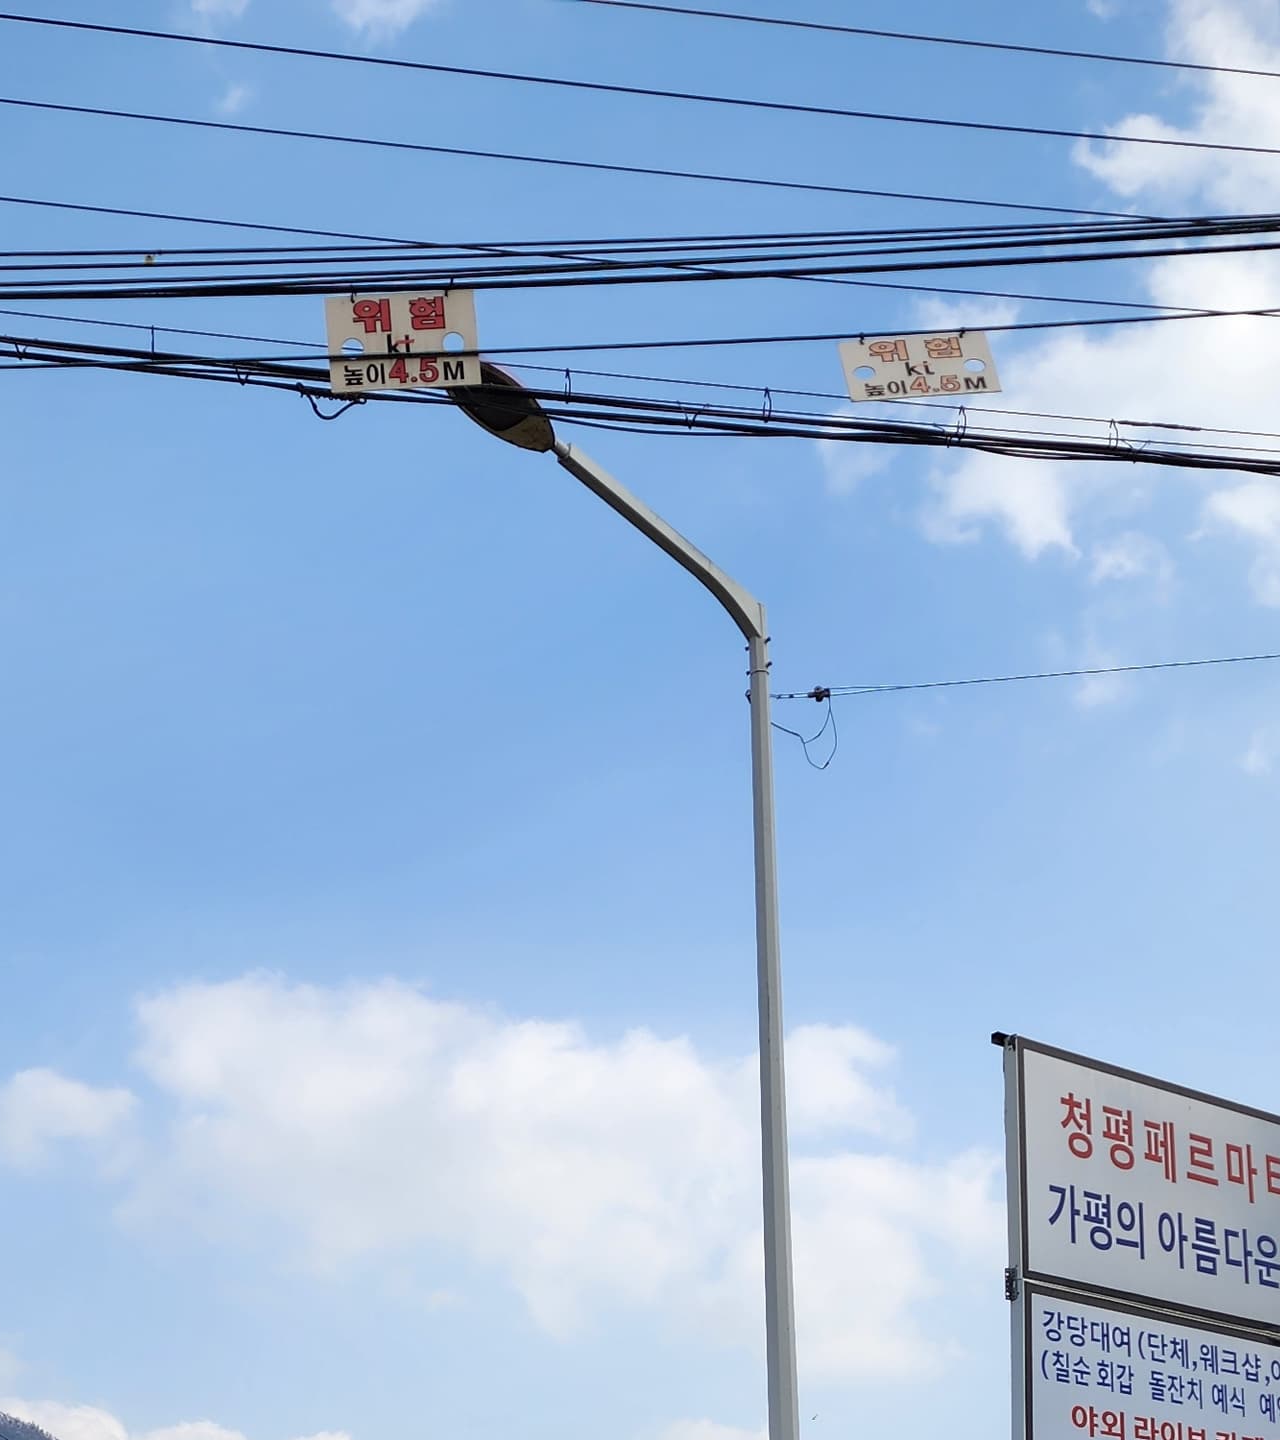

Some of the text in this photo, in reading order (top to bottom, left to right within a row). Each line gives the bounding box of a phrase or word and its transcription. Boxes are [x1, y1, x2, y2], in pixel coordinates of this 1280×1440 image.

[352, 296, 446, 333] 위험
[387, 334, 415, 353] kt
[869, 336, 963, 362] 위험
[1048, 1184, 1145, 1260] 가평의
[1096, 1359, 1135, 1396] 회갑
[1148, 1372, 1203, 1410] 돌잔치
[1211, 1382, 1246, 1417] 예식
